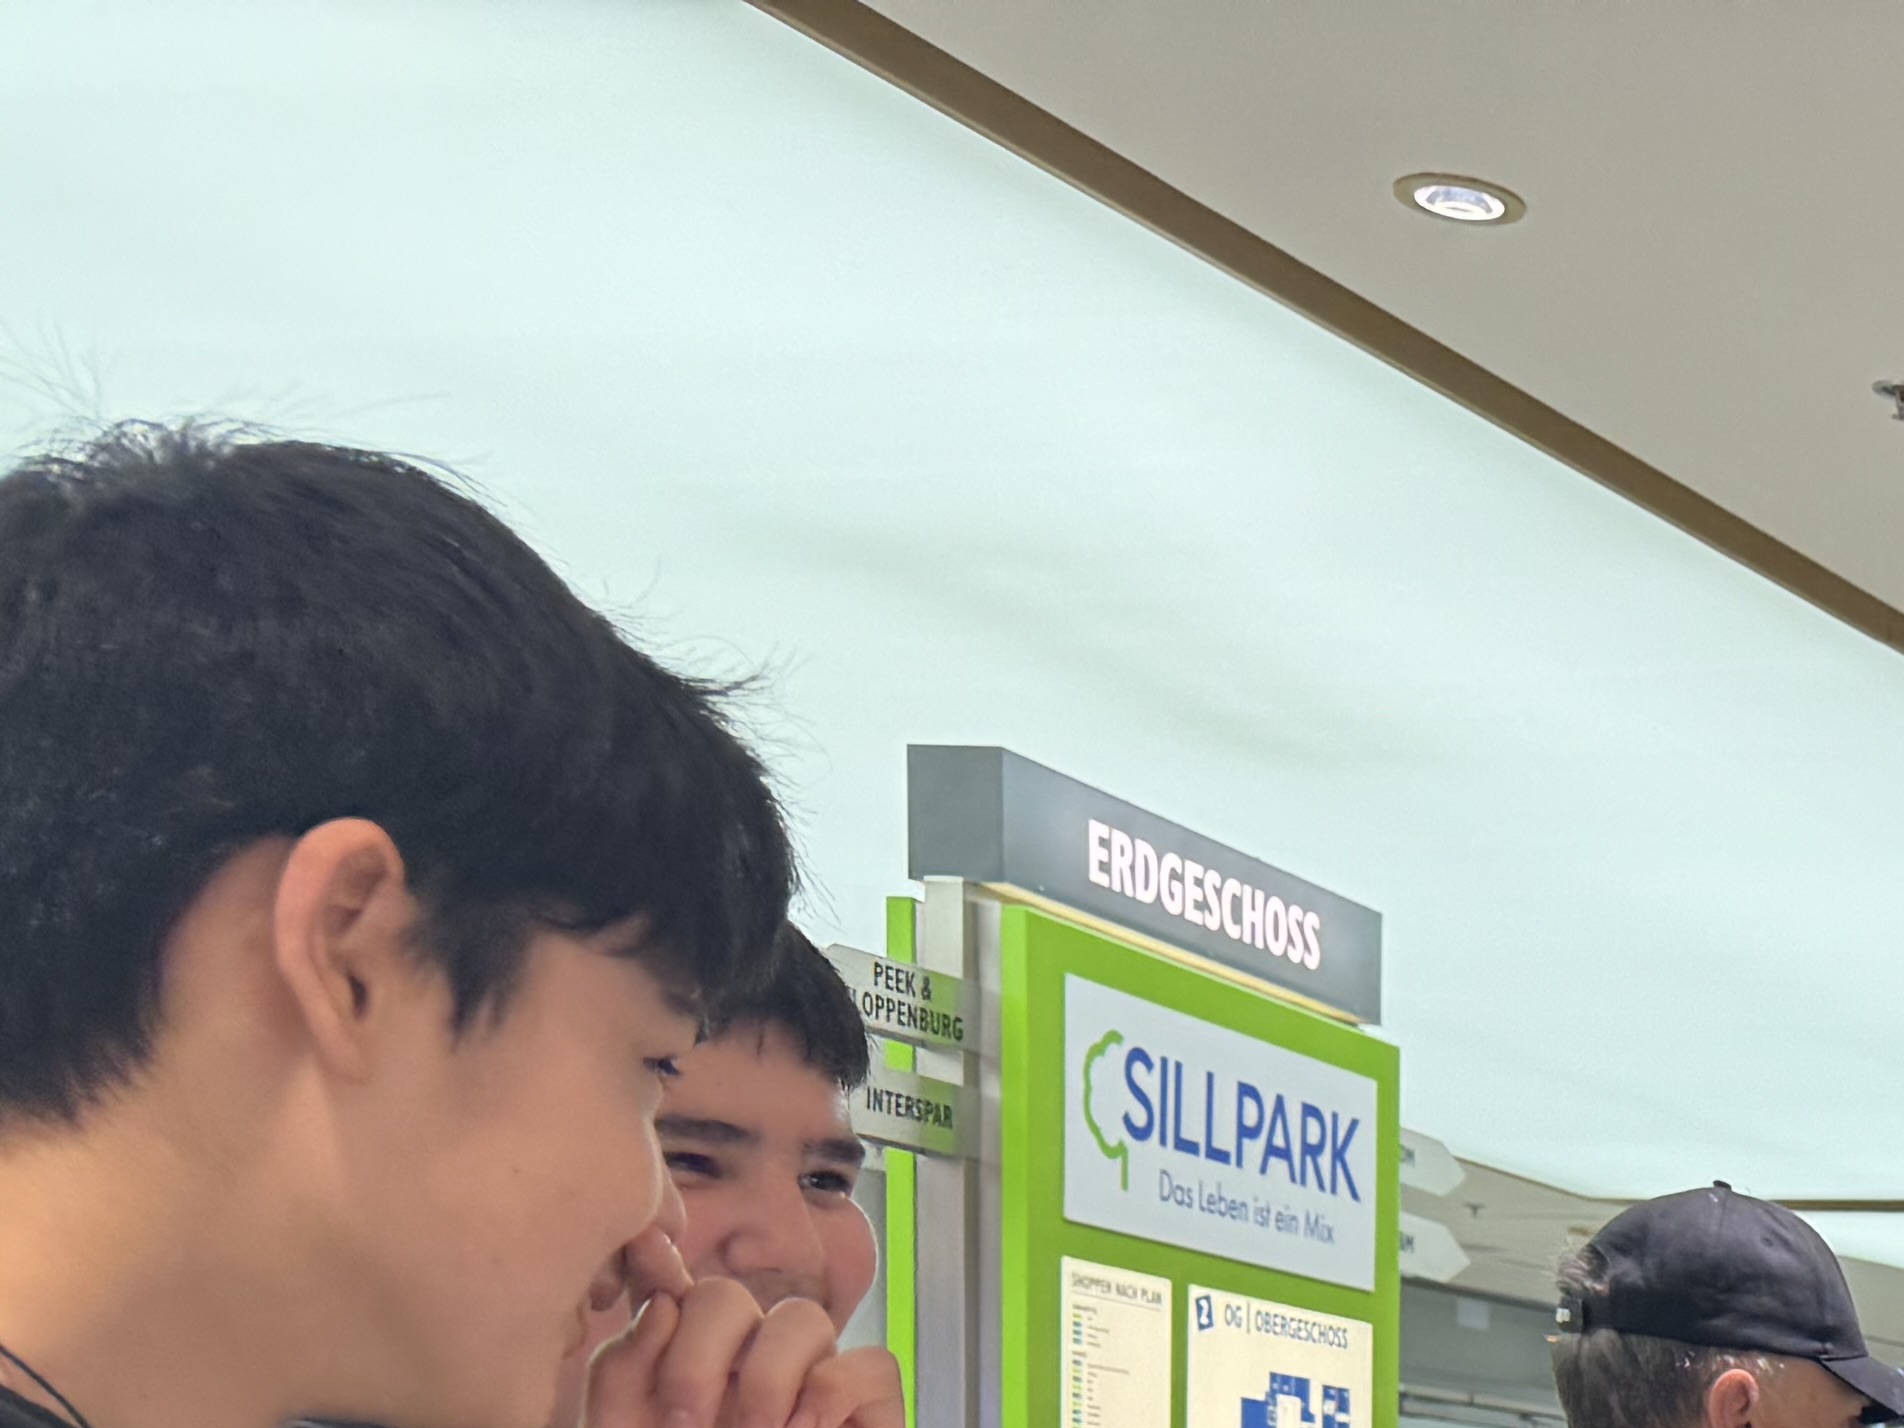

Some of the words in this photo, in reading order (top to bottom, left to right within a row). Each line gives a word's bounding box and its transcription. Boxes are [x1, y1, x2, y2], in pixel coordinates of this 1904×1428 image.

[1088, 818, 1321, 971] ERDGESCHOSS
[874, 961, 916, 997] PEEK
[921, 976, 932, 1000] &
[851, 989, 964, 1042] OPPENBURG
[866, 1086, 953, 1130] INTERSPAR
[1122, 1046, 1361, 1202] SILLPARK
[1159, 1168, 1193, 1209] Das
[1198, 1178, 1249, 1222] Leben
[1253, 1195, 1271, 1228] ist
[1275, 1204, 1298, 1235] ein
[1304, 1209, 1335, 1244] Mix
[1224, 1303, 1242, 1329] OG
[1255, 1310, 1348, 1350] OBERGESCHOSS
